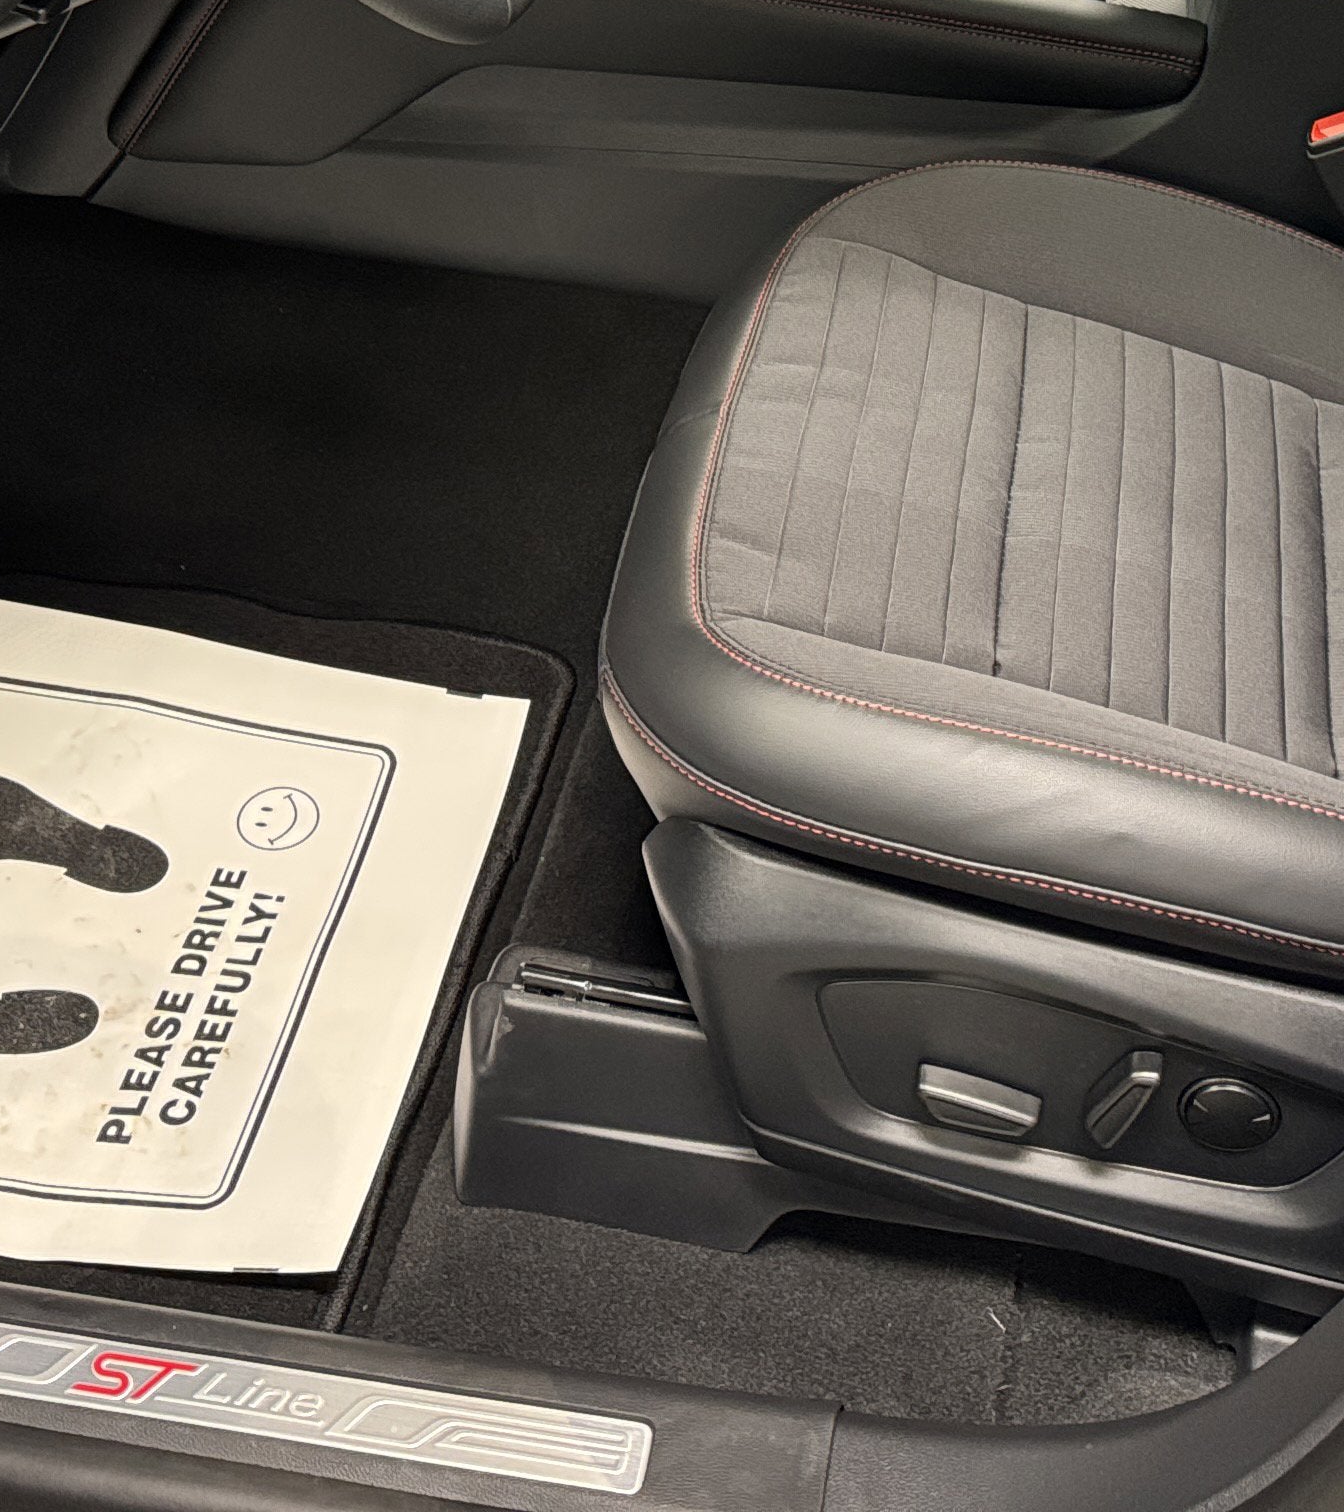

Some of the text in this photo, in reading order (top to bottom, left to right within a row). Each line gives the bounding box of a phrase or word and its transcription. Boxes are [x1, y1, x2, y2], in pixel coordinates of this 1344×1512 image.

[96, 868, 248, 1145] PLEASE DRIVE
[158, 892, 286, 1126] CAREFULLY!
[65, 1351, 325, 1417] ST Line
